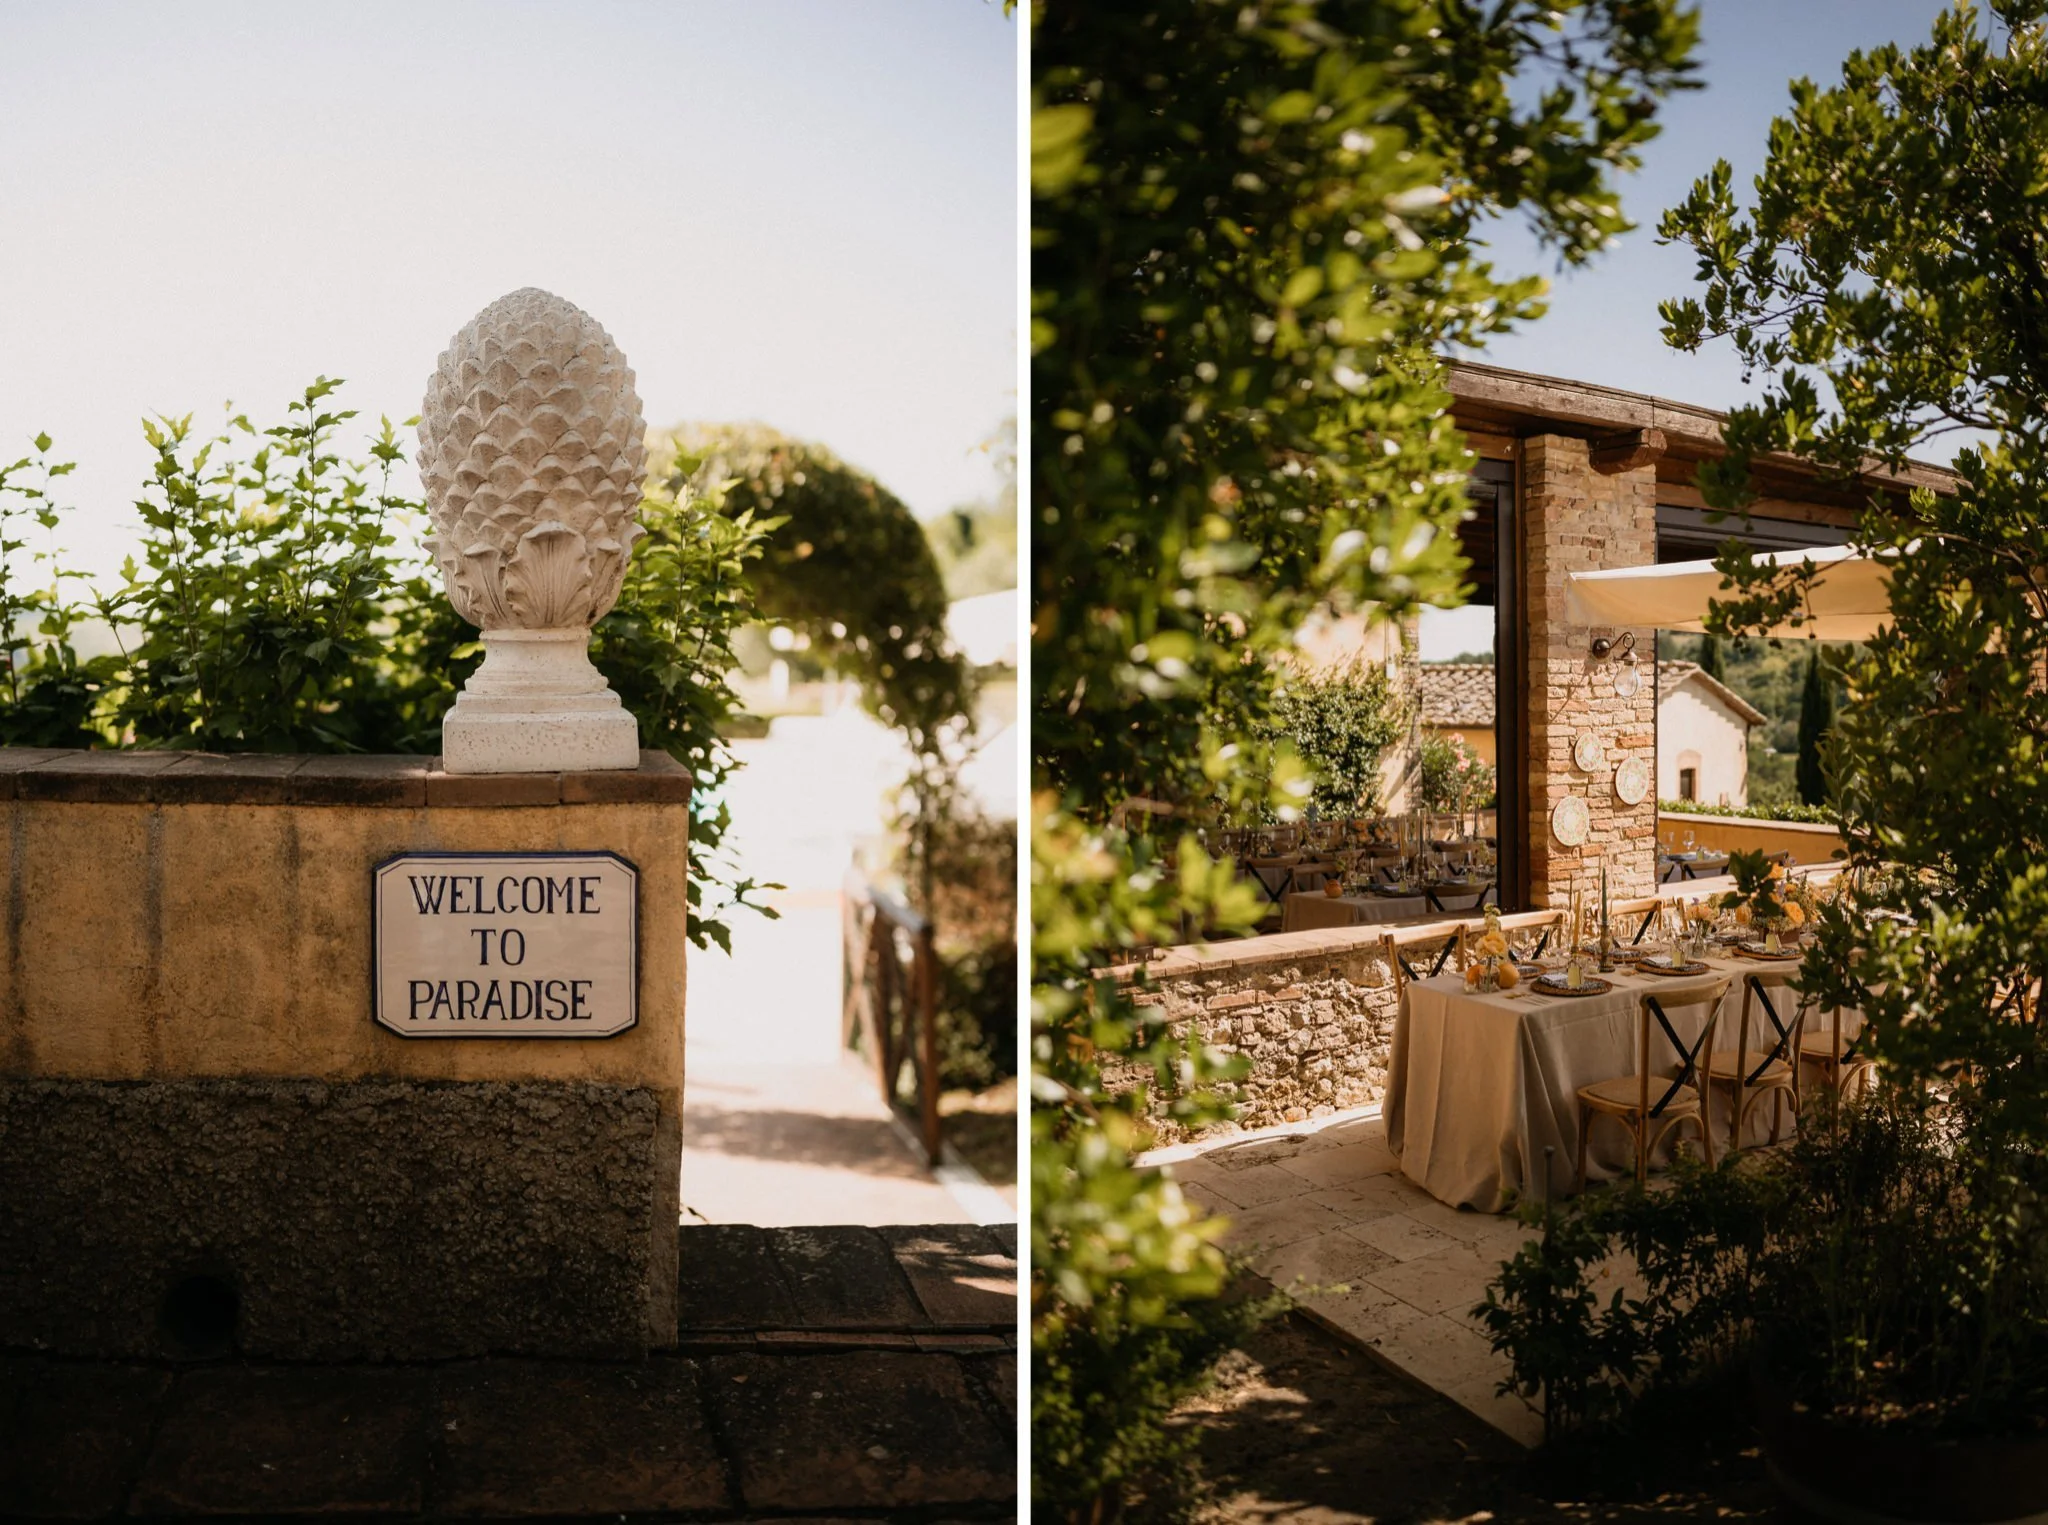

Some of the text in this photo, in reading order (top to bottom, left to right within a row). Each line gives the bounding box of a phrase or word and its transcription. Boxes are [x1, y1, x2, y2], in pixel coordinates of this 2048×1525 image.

[408, 876, 601, 914] WELCOME
[471, 929, 526, 966] TO
[408, 980, 592, 1021] PARADISE
